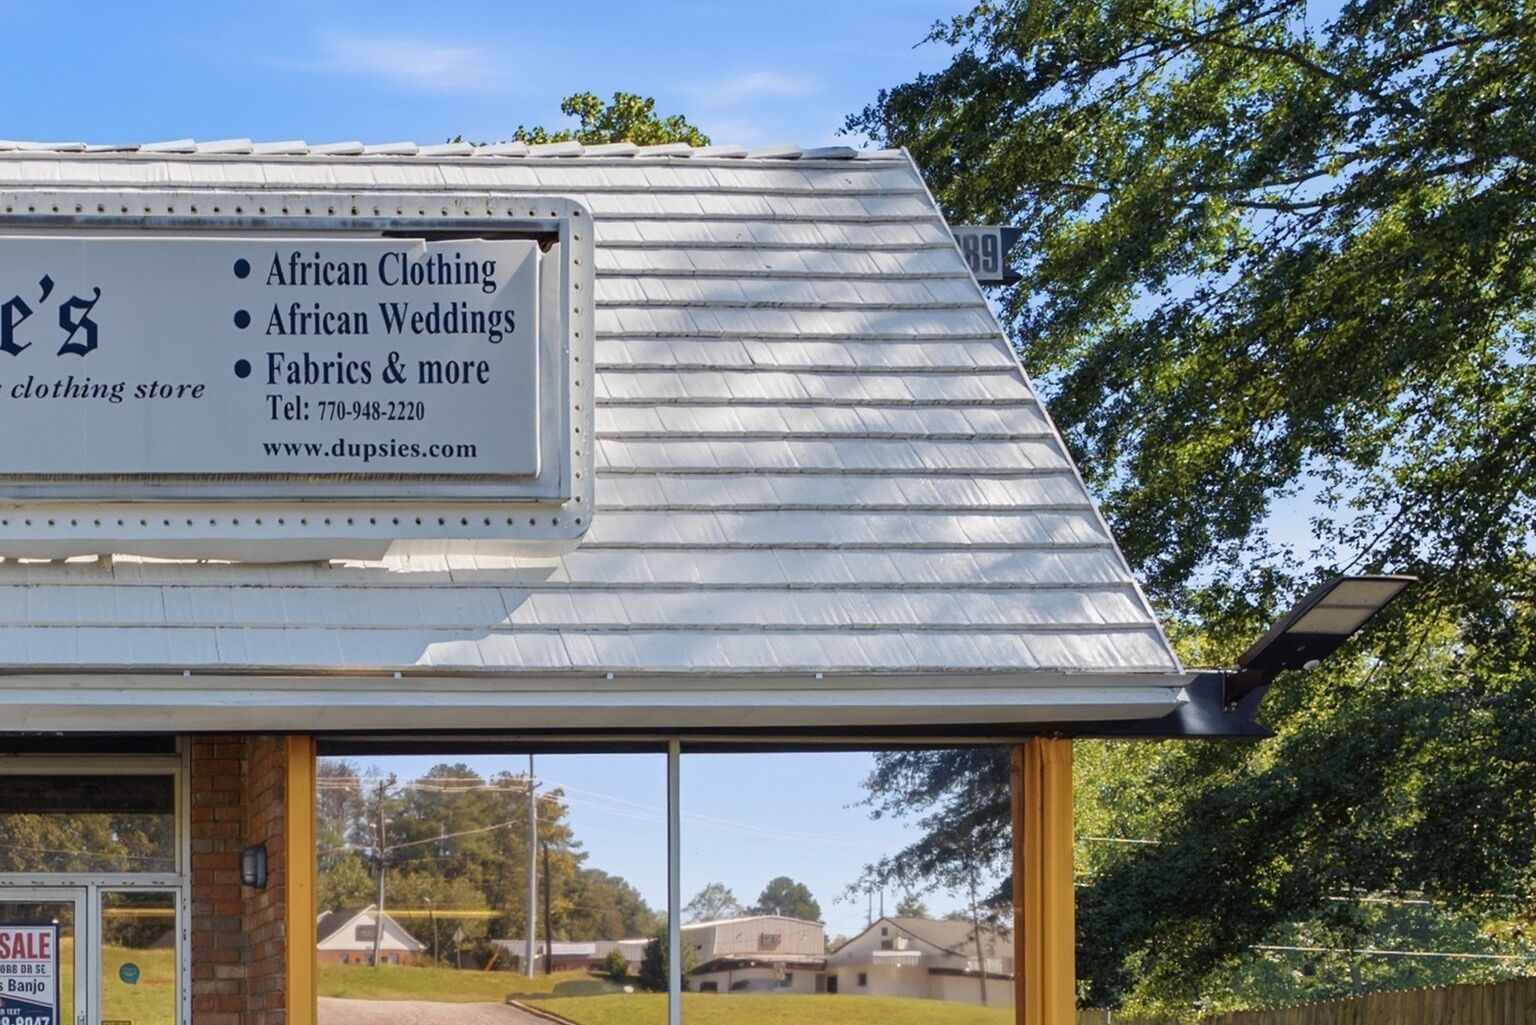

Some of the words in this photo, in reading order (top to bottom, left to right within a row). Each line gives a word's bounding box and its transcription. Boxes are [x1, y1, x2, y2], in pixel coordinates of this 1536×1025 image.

[953, 233, 999, 273] 89
[266, 251, 368, 286] African
[378, 251, 497, 294] Clothing
[265, 302, 368, 335] African
[379, 302, 516, 344] Weddings
[266, 352, 372, 385] Fabrics
[382, 351, 407, 385] &
[418, 359, 490, 385] more
[10, 375, 126, 405] clothing
[135, 379, 206, 400] store
[266, 395, 310, 421] Tel:
[318, 400, 425, 421] 770-948-2220
[263, 438, 477, 462] www.dupsies.com
[8, 978, 45, 995] Banjo
